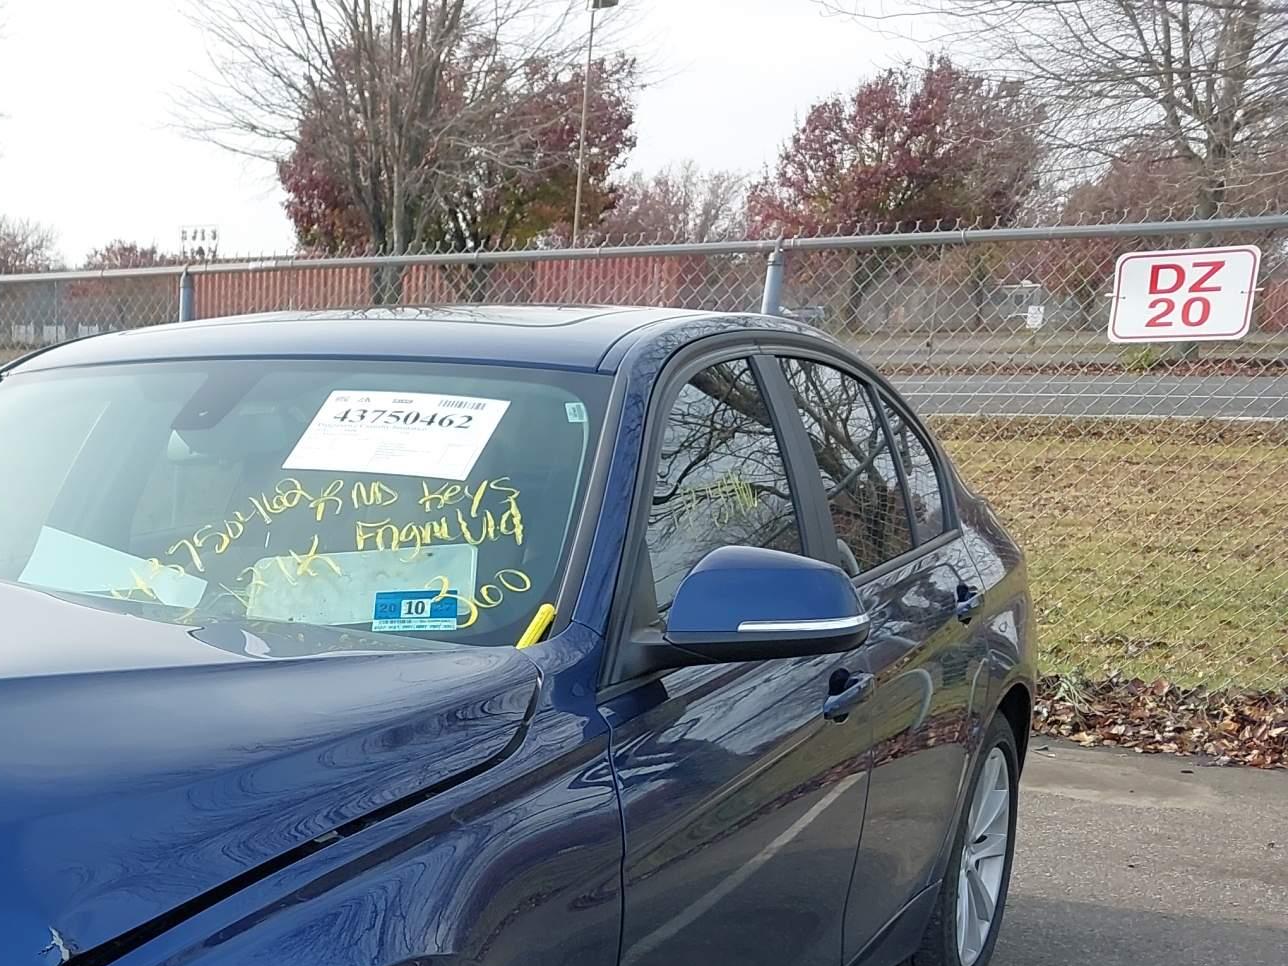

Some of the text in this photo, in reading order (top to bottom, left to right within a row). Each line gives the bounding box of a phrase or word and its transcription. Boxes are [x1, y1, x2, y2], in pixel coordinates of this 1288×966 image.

[1148, 260, 1226, 295] DZ
[1144, 296, 1211, 327] 20
[333, 408, 473, 429] 43750462
[404, 600, 426, 615] 10
